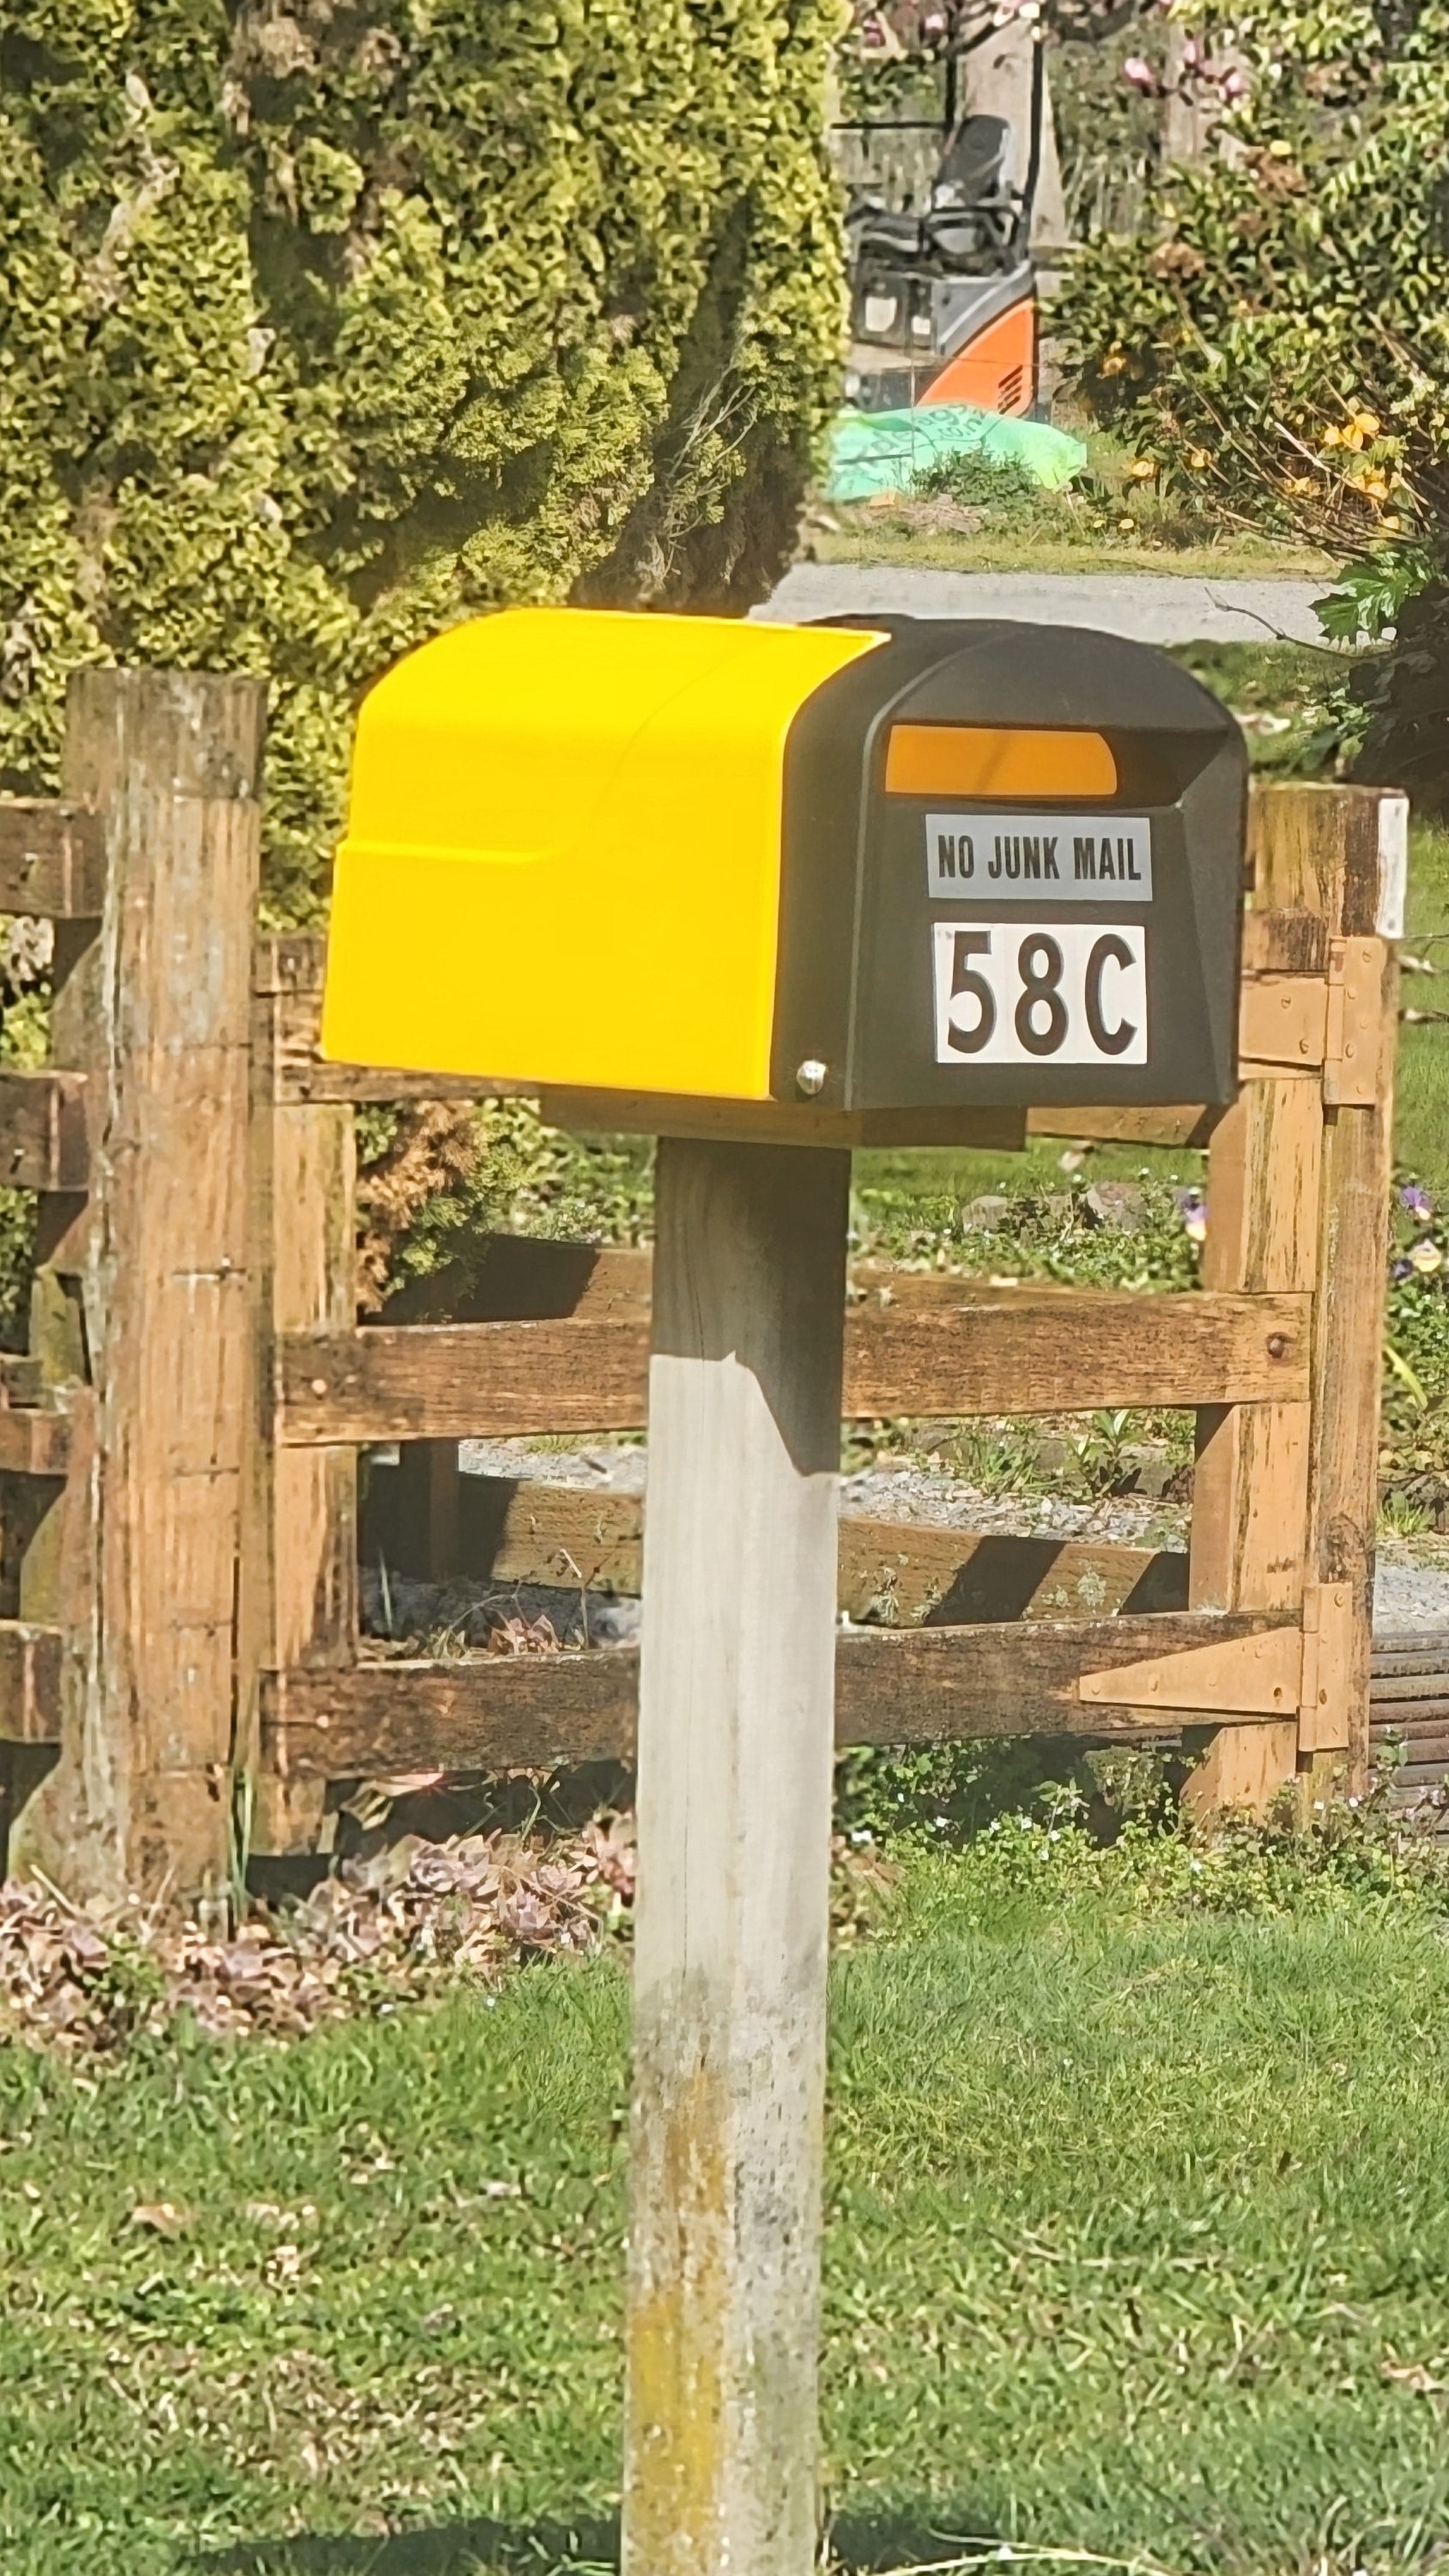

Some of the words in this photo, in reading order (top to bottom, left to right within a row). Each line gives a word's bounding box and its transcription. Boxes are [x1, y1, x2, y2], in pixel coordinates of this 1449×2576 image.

[937, 835, 974, 879] NO
[987, 835, 1060, 880] JUNK
[1073, 836, 1142, 881] MAIL
[947, 930, 1138, 1056] 58C
